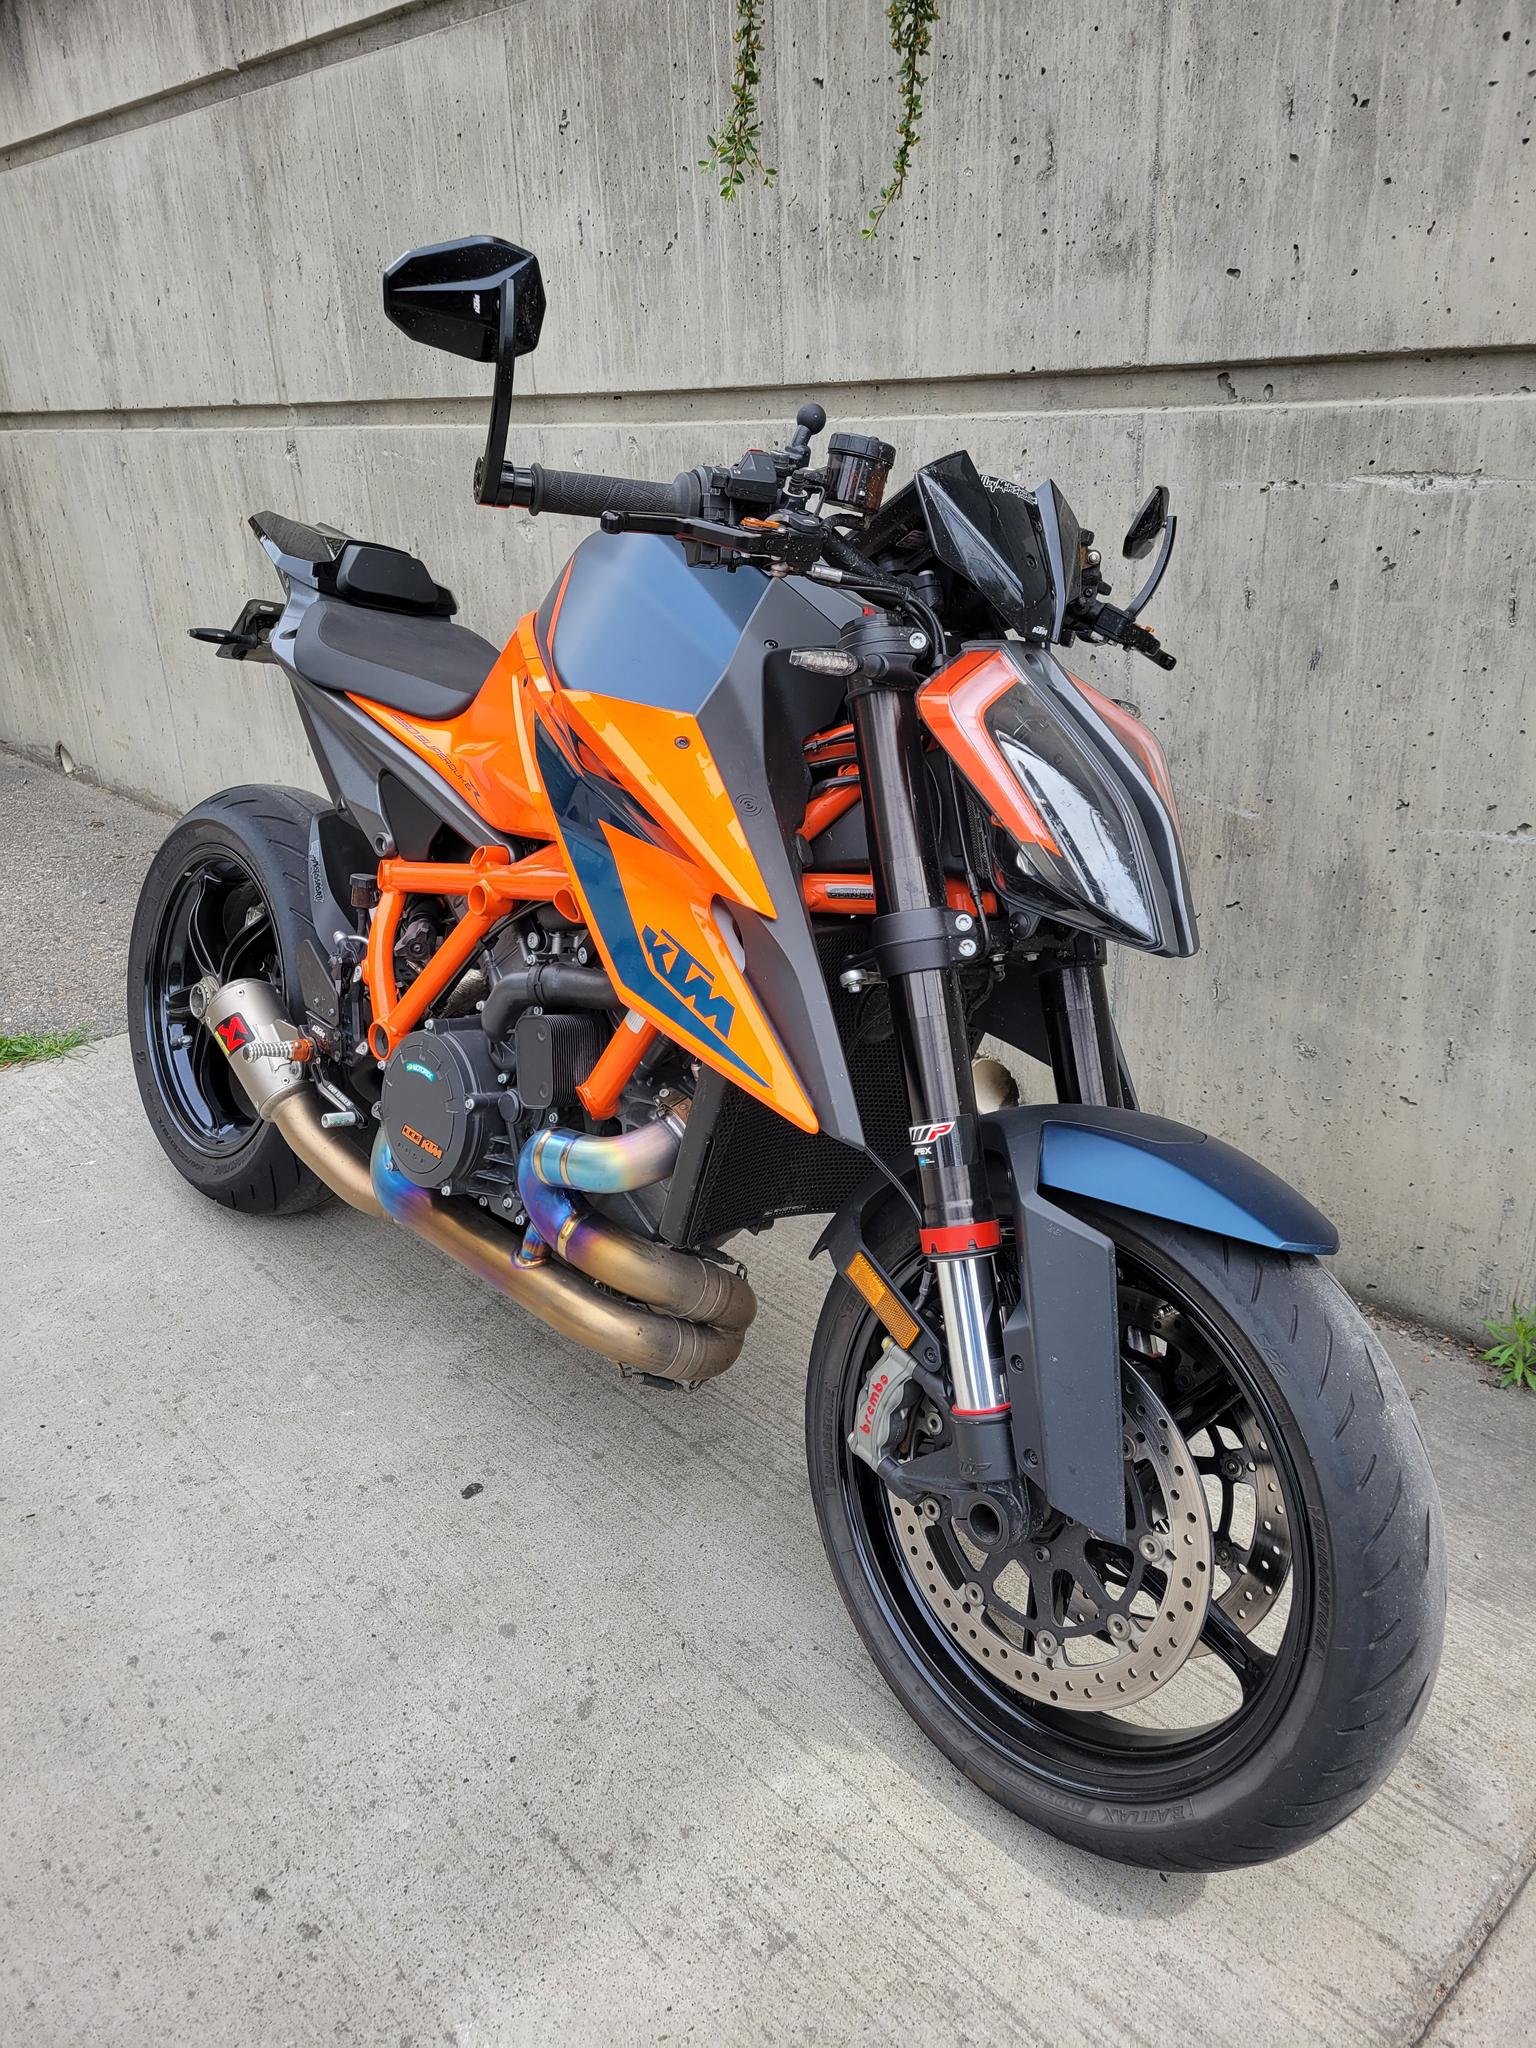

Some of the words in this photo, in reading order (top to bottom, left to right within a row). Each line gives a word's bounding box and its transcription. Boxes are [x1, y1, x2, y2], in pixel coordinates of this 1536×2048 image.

[1031, 625, 1048, 636] KTM
[641, 924, 736, 1040] KTM
[310, 1024, 326, 1039] KTM
[421, 1139, 443, 1160] KTM
[860, 1374, 889, 1435] brembo
[1103, 1804, 1185, 1826] BATTLAX
